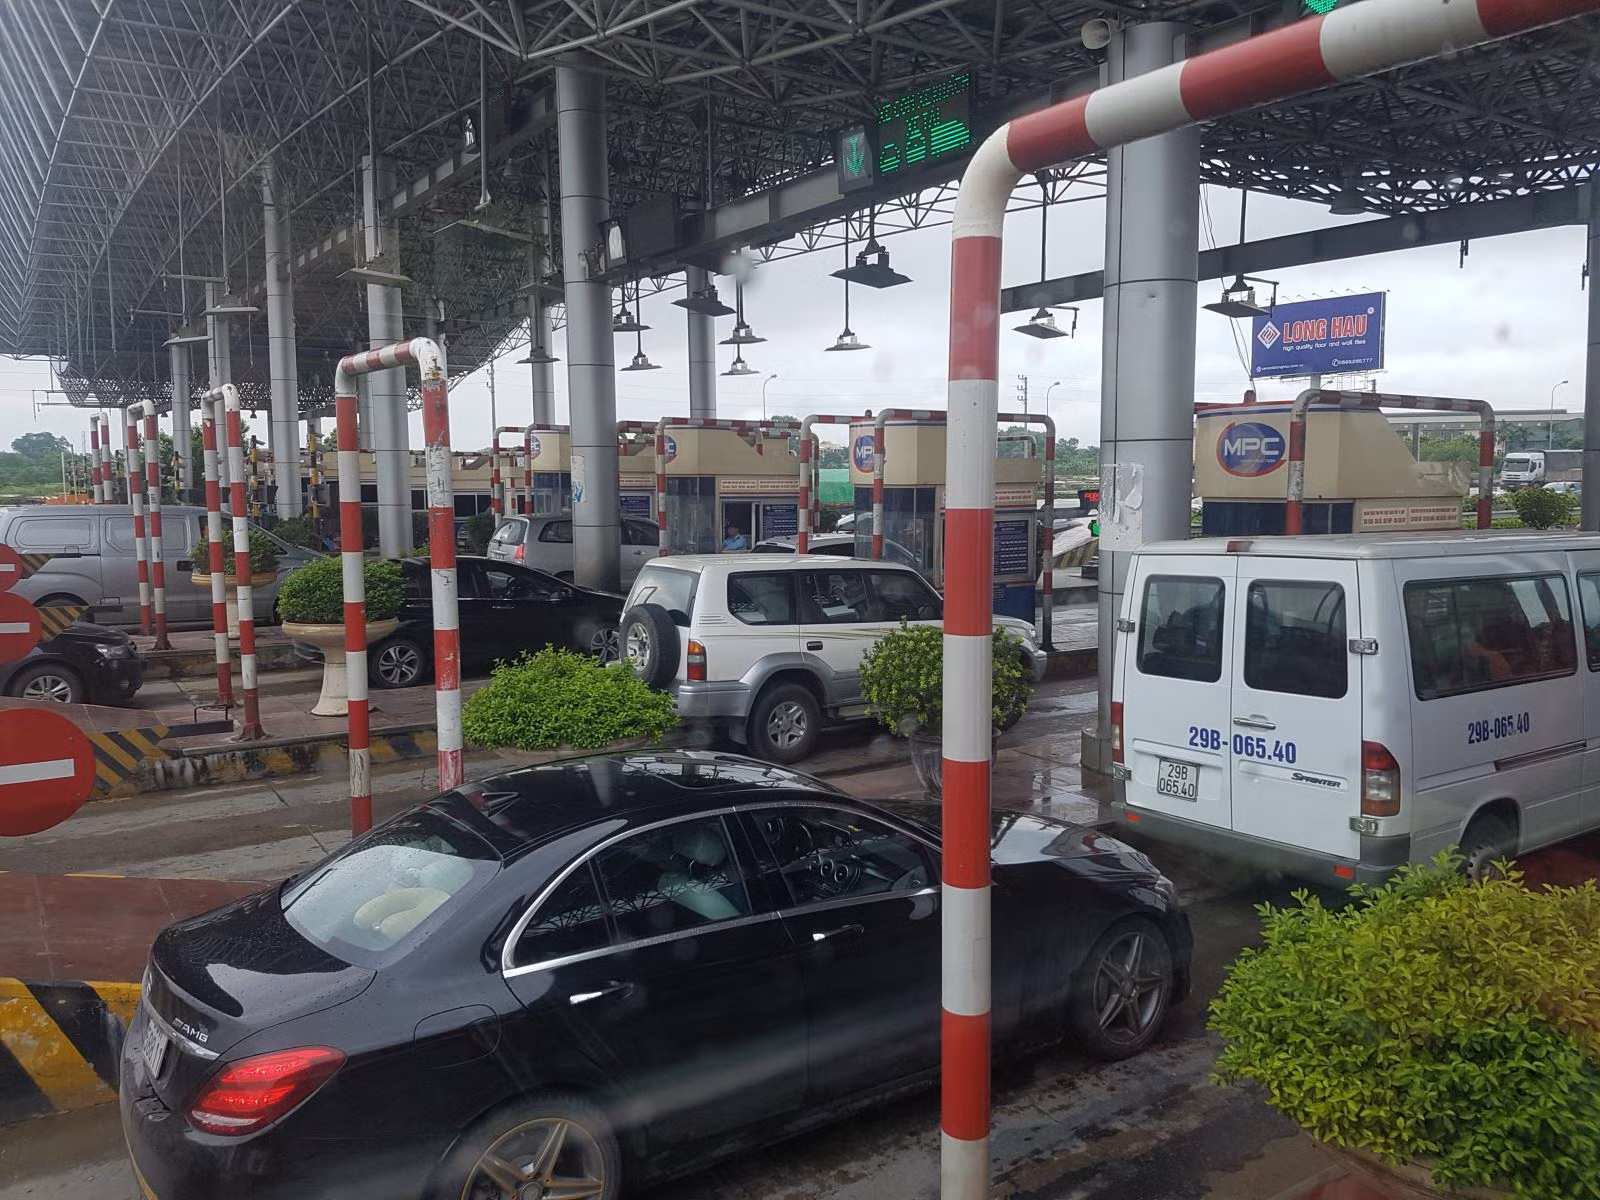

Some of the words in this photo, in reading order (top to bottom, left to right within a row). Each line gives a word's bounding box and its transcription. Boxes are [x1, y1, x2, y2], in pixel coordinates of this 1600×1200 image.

[1282, 318, 1327, 344] LONG
[1330, 314, 1368, 339] HAU
[1295, 343, 1313, 351] quality
[856, 445, 875, 459] MP
[1224, 437, 1280, 457] MPC
[1468, 711, 1530, 744] 29B-065.40
[1168, 763, 1188, 780] 29B
[1160, 777, 1195, 797] 065.40
[182, 1023, 209, 1043] AMG
